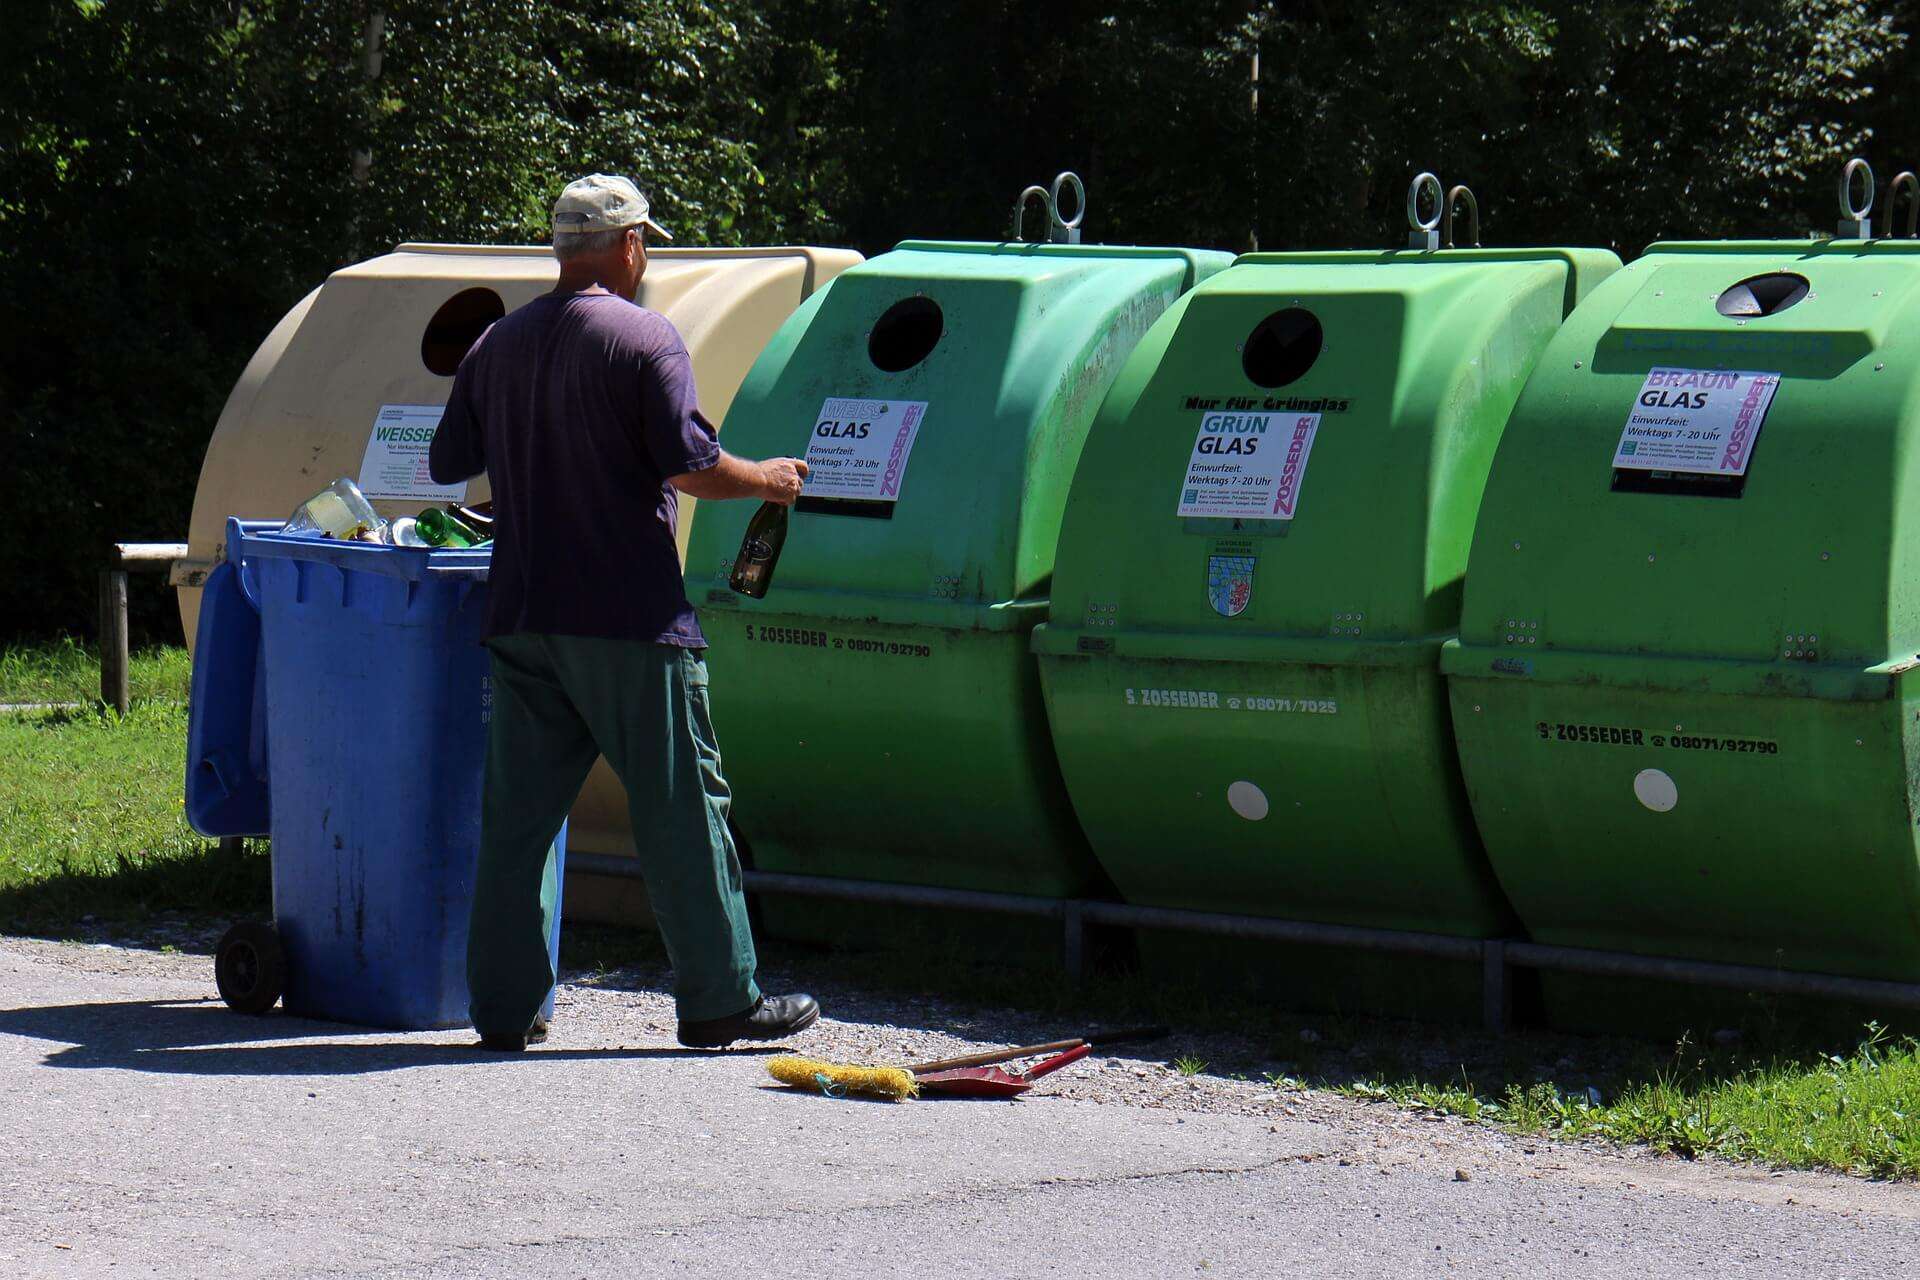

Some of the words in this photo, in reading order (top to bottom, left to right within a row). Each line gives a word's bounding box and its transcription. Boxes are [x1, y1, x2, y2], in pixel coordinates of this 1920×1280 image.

[1647, 370, 1739, 390] BRAUN
[1186, 397, 1220, 410] Nur
[1263, 397, 1348, 411] Grünglas
[1640, 390, 1708, 409] GLAS
[824, 400, 883, 420] WEISS
[816, 421, 871, 439] GLAS
[1204, 415, 1270, 433] GRÜN
[1631, 415, 1690, 427] Einwurfzeit:
[1627, 427, 1672, 439] Werktags
[1702, 429, 1721, 441] Uhr
[810, 445, 855, 456] Einwurfzeit:
[880, 404, 922, 496] ZOSSEDER
[1198, 437, 1258, 455] GLAS
[807, 457, 842, 468] Werktags
[865, 459, 880, 468] Uhr
[1191, 463, 1242, 473] Einwurfzeit:
[1273, 416, 1312, 515] ZOSSEDER
[1188, 475, 1229, 486] Werktags
[1255, 477, 1272, 486] Uhr
[745, 624, 757, 641] S.
[760, 626, 827, 648] ZOSSEDER
[847, 638, 931, 657] 08071/92790
[1126, 688, 1139, 705] S.
[1141, 689, 1219, 709] ZOSSEDER
[1246, 697, 1337, 714] 08071/7025
[1556, 723, 1644, 746] ZOSSEDER
[1670, 735, 1778, 754] 08071/92790
